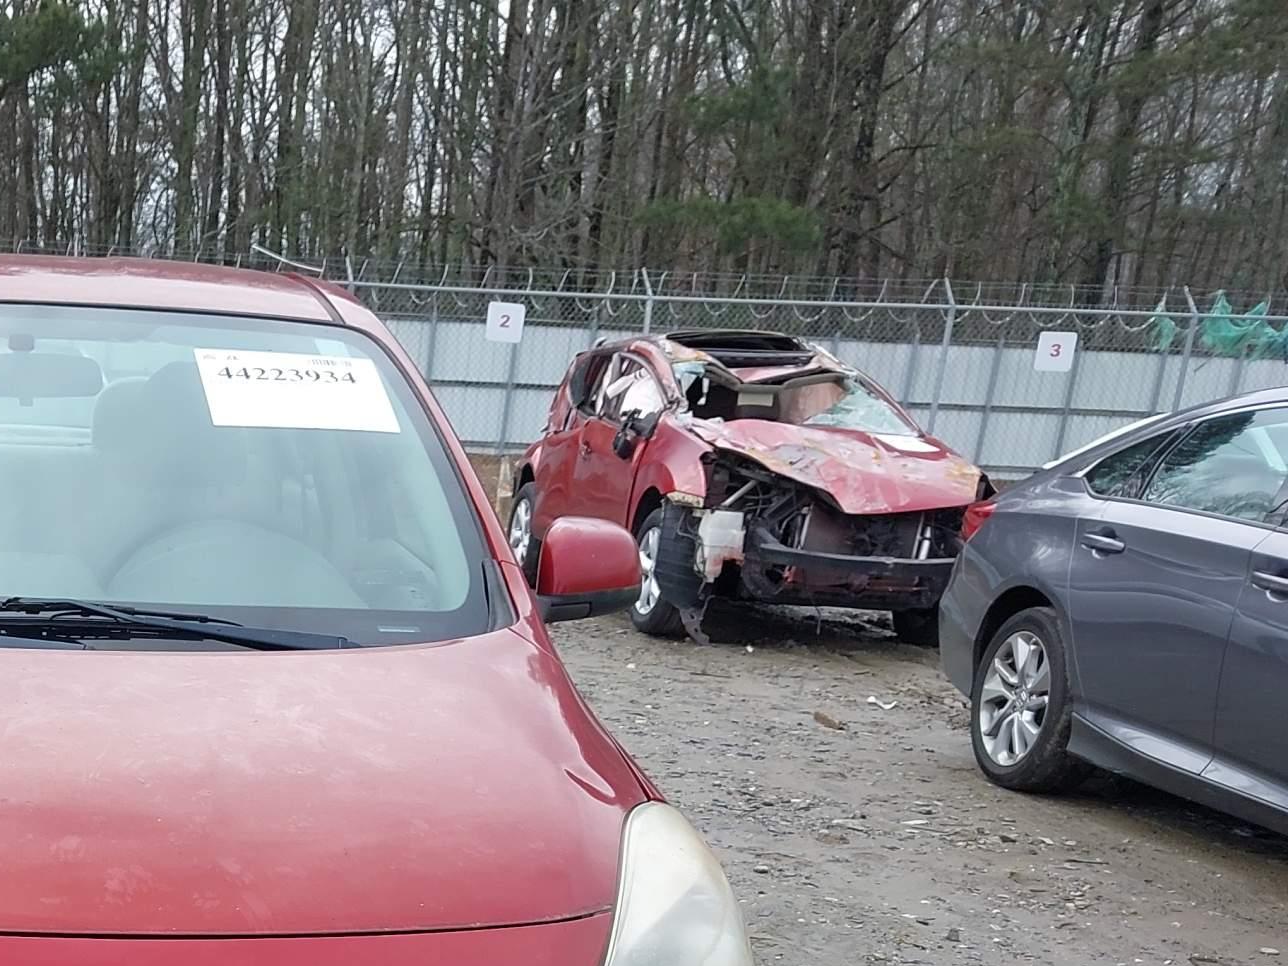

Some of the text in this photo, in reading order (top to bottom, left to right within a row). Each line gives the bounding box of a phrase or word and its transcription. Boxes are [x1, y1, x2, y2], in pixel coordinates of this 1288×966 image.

[499, 314, 511, 329] 2
[1049, 343, 1062, 358] 3
[217, 366, 357, 384] 44223934
